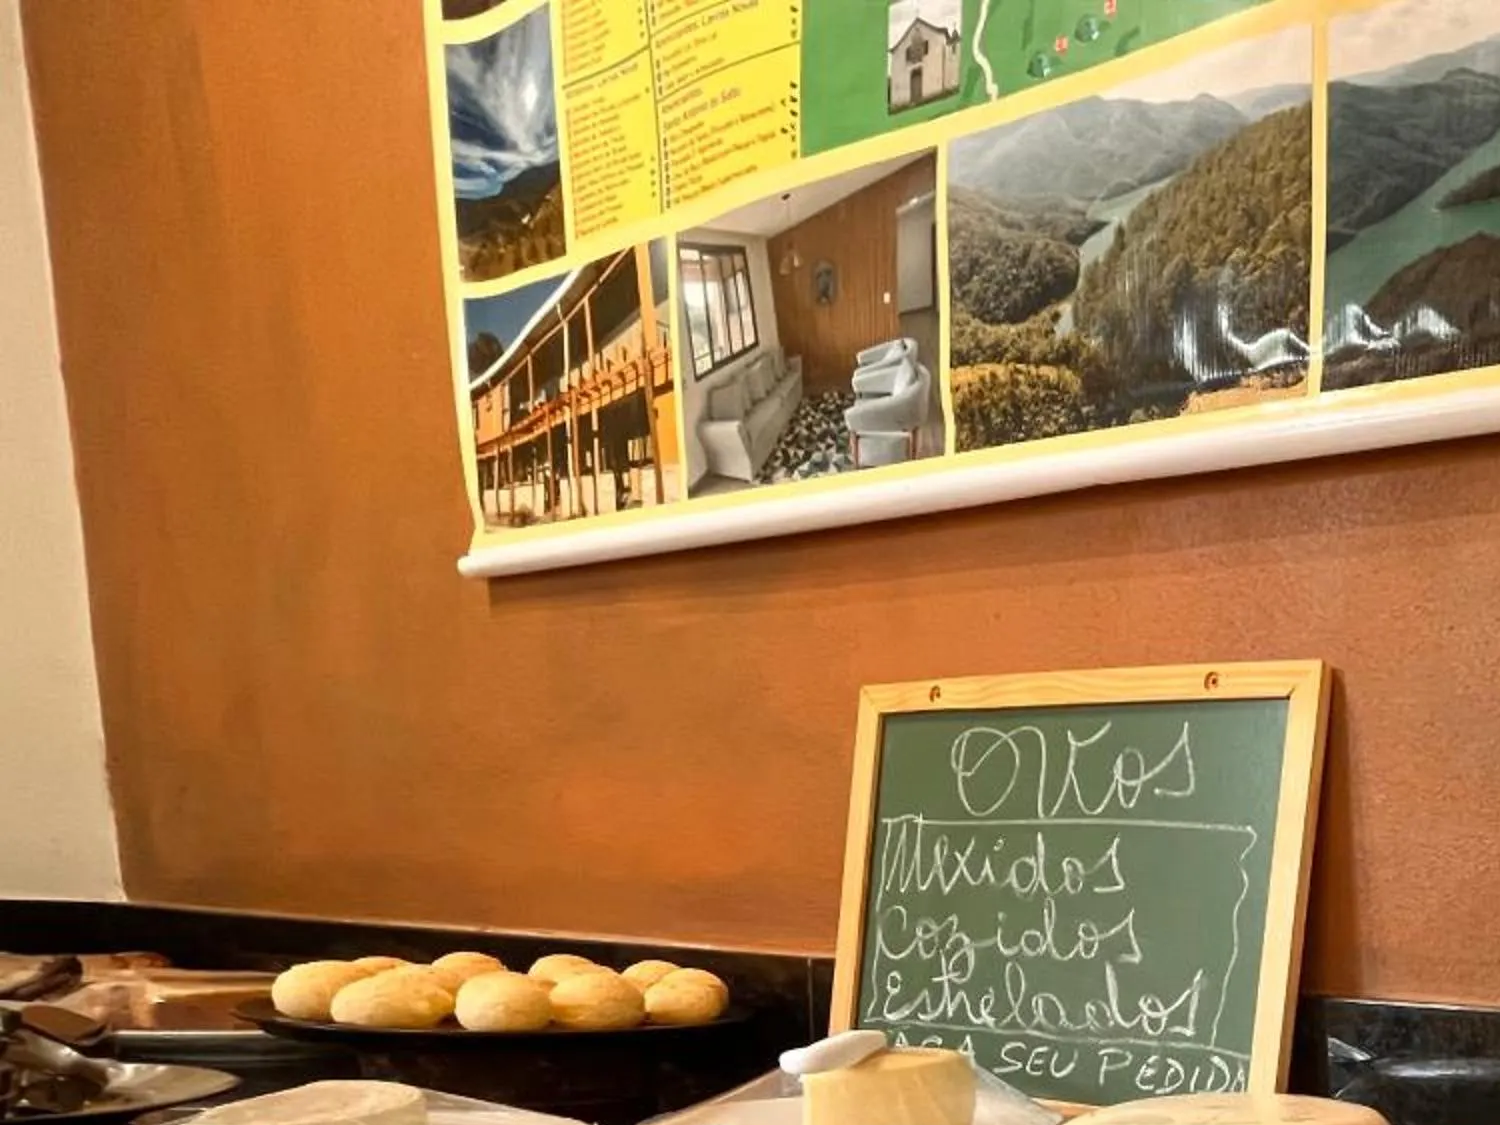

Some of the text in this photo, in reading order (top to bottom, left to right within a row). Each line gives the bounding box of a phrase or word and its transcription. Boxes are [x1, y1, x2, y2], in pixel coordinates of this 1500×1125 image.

[881, 818, 1126, 897] Mexidos
[877, 898, 1143, 984] Cozidos
[883, 950, 1204, 1036] Estrelados
[993, 1041, 1079, 1079] SEU
